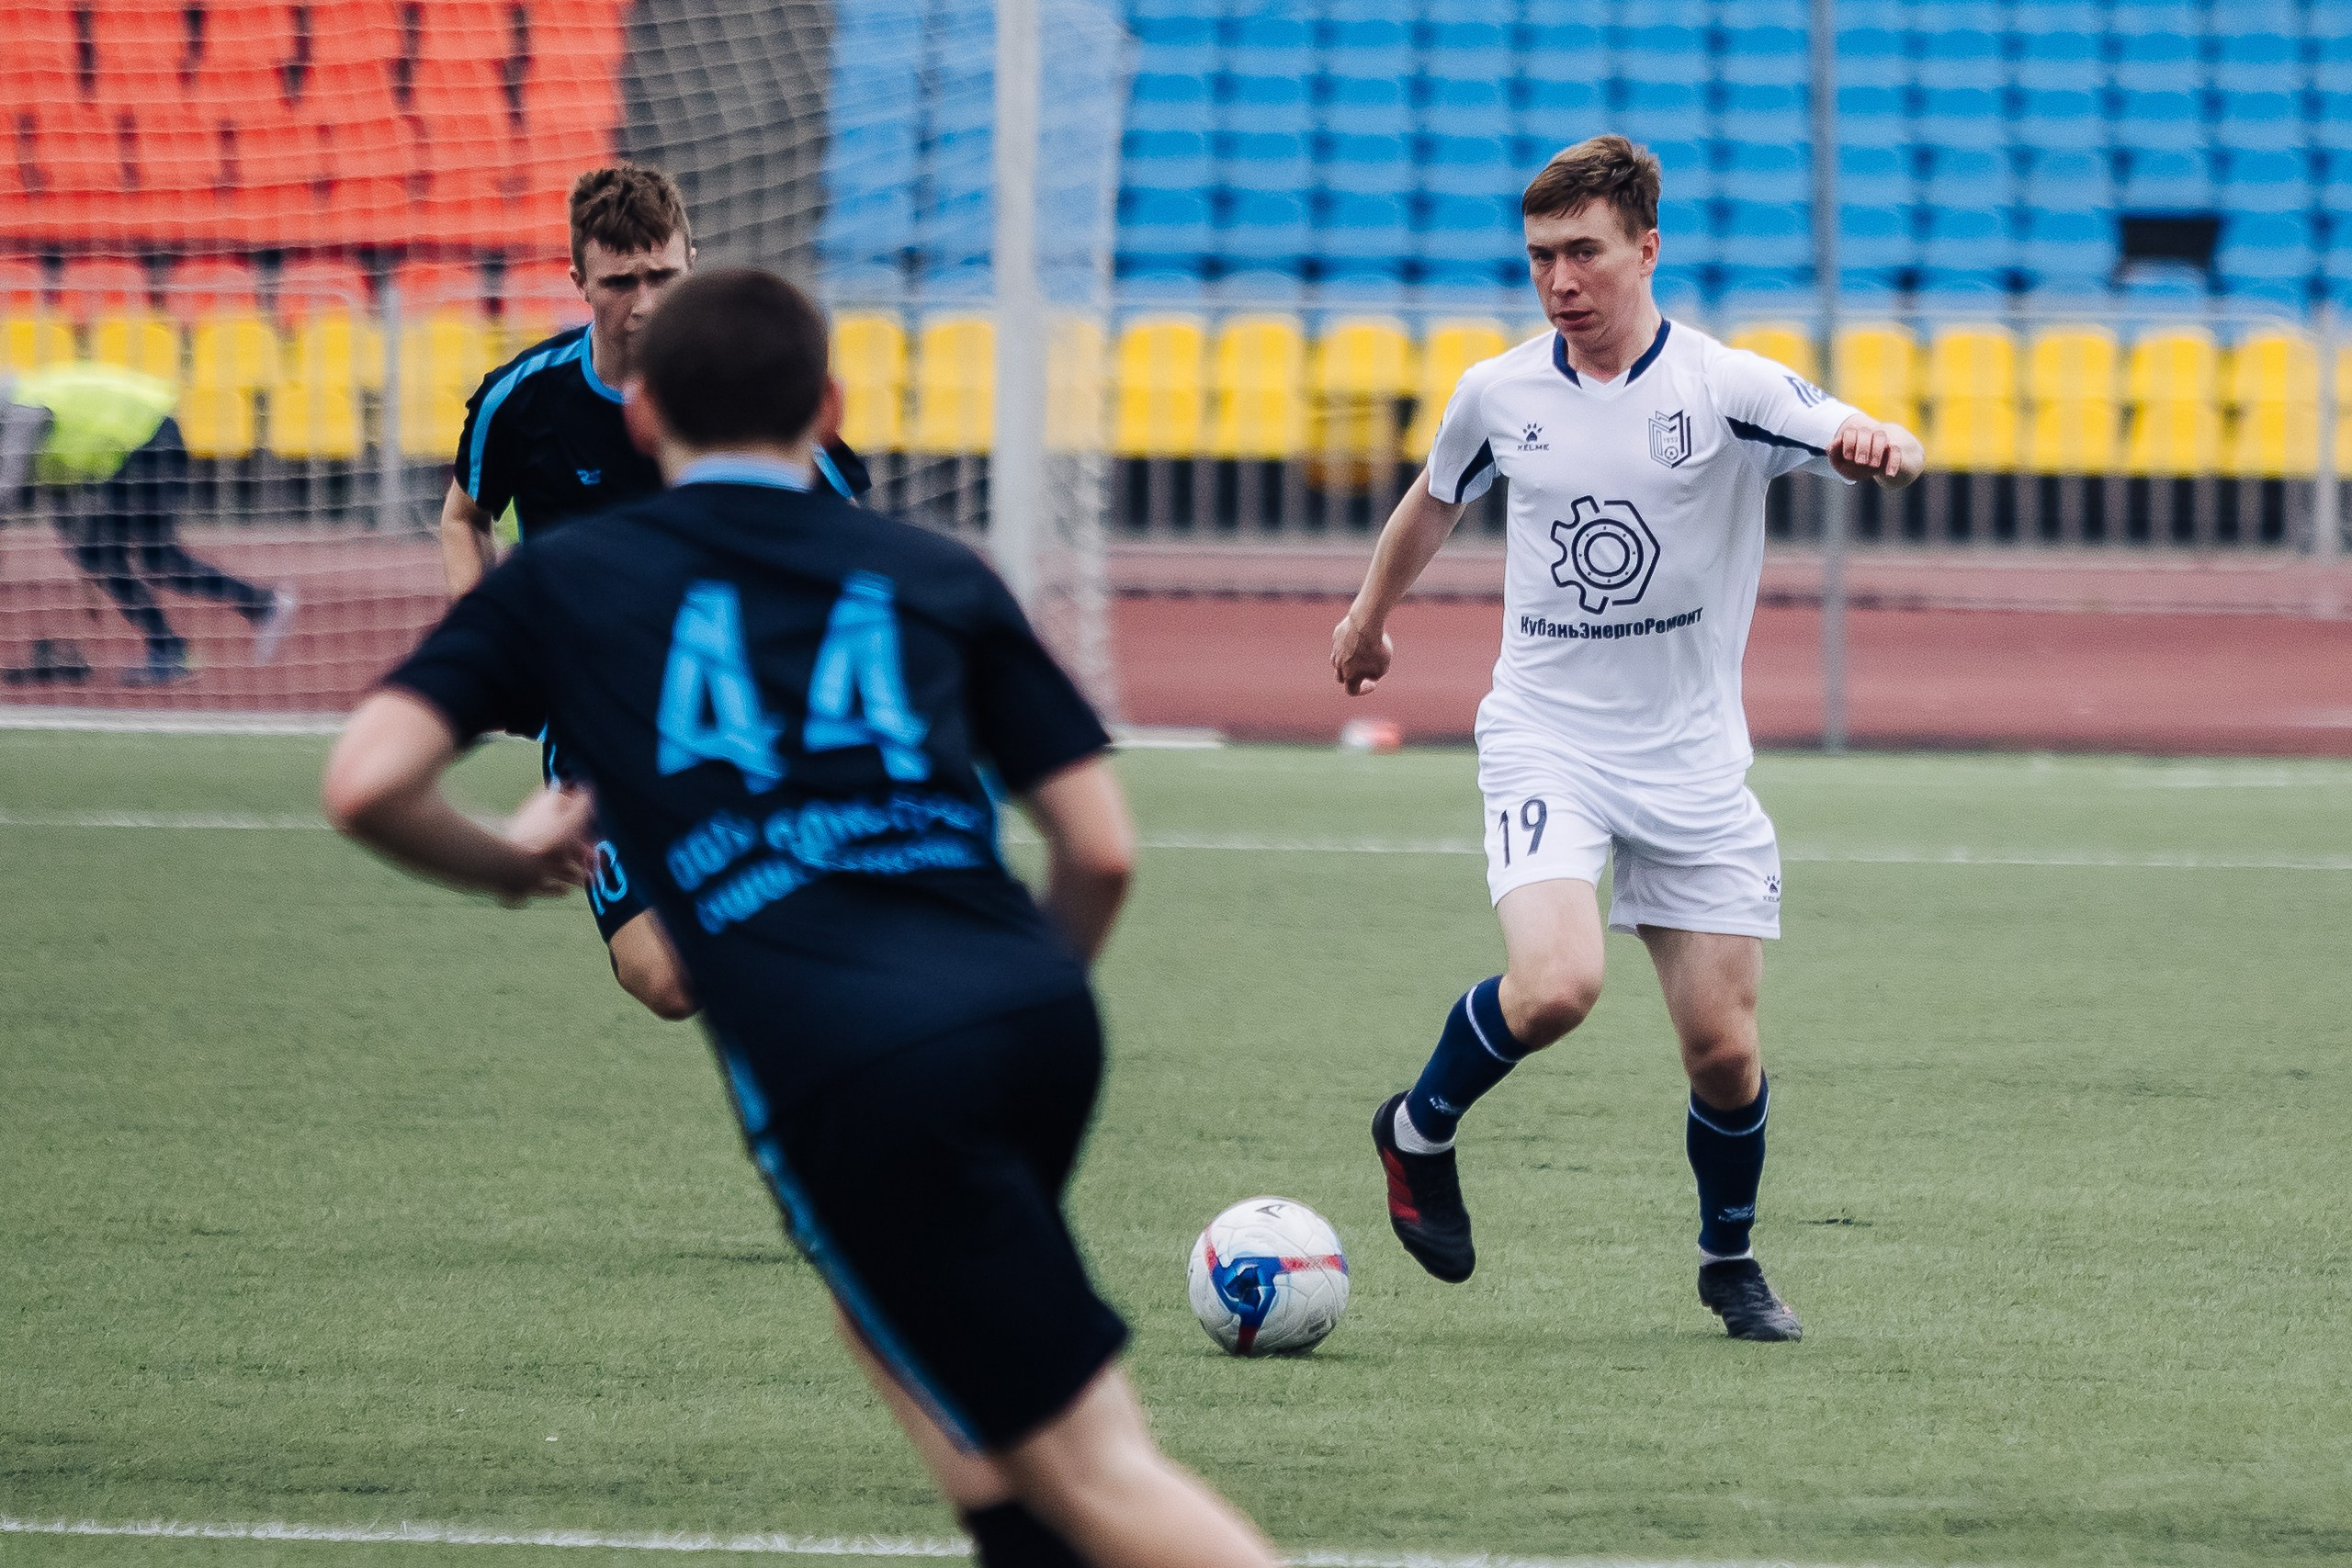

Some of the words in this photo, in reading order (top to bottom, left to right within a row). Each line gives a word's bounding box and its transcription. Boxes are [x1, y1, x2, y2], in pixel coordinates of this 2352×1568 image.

[1517, 443, 1549, 451] KELME
[1521, 607, 1704, 639] КубаньЭнергоРемонт
[656, 570, 932, 794] 44
[1497, 798, 1548, 869] 19
